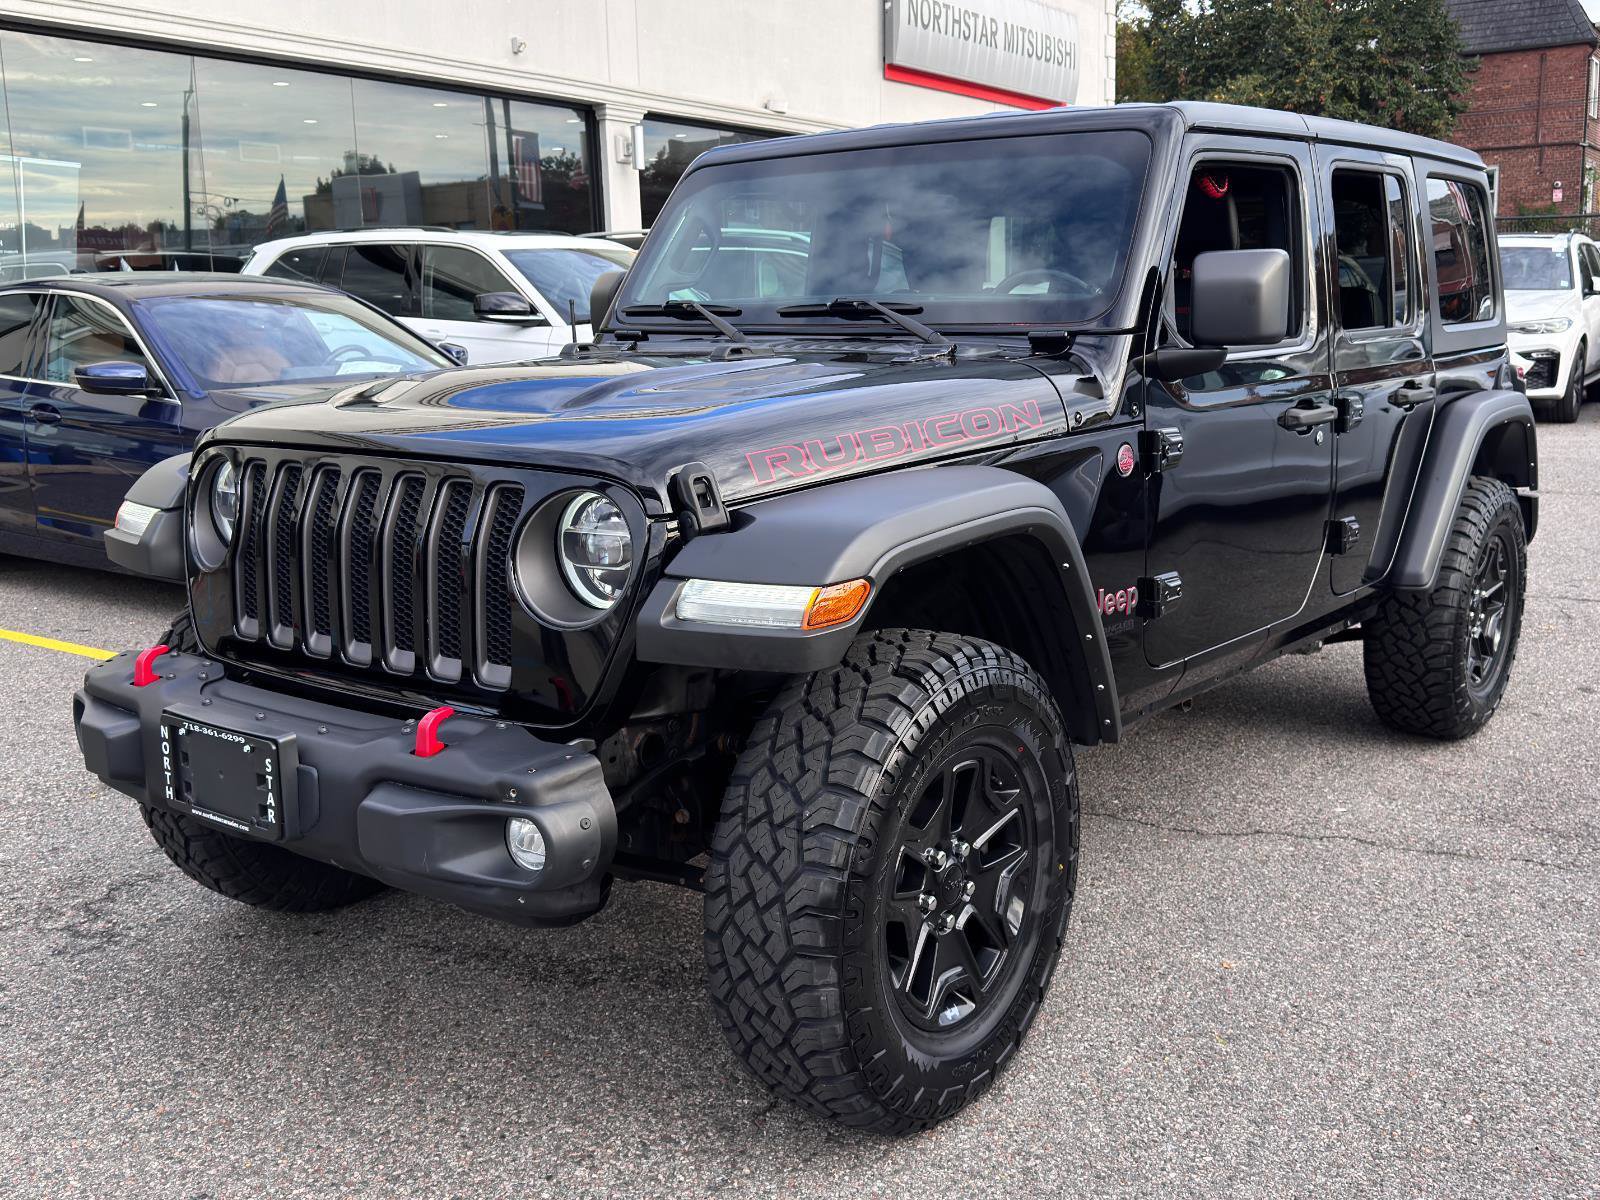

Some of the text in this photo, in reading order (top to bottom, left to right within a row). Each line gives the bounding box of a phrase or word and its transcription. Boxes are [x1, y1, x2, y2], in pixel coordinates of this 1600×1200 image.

[907, 0, 1077, 70] NORTHSTAR MITSUBISHI
[745, 399, 1043, 485] RUBICON
[1097, 586, 1138, 617] Jeep
[160, 725, 174, 800] NORTH
[183, 722, 246, 744] 718-361-6299
[265, 759, 276, 824] STAR
